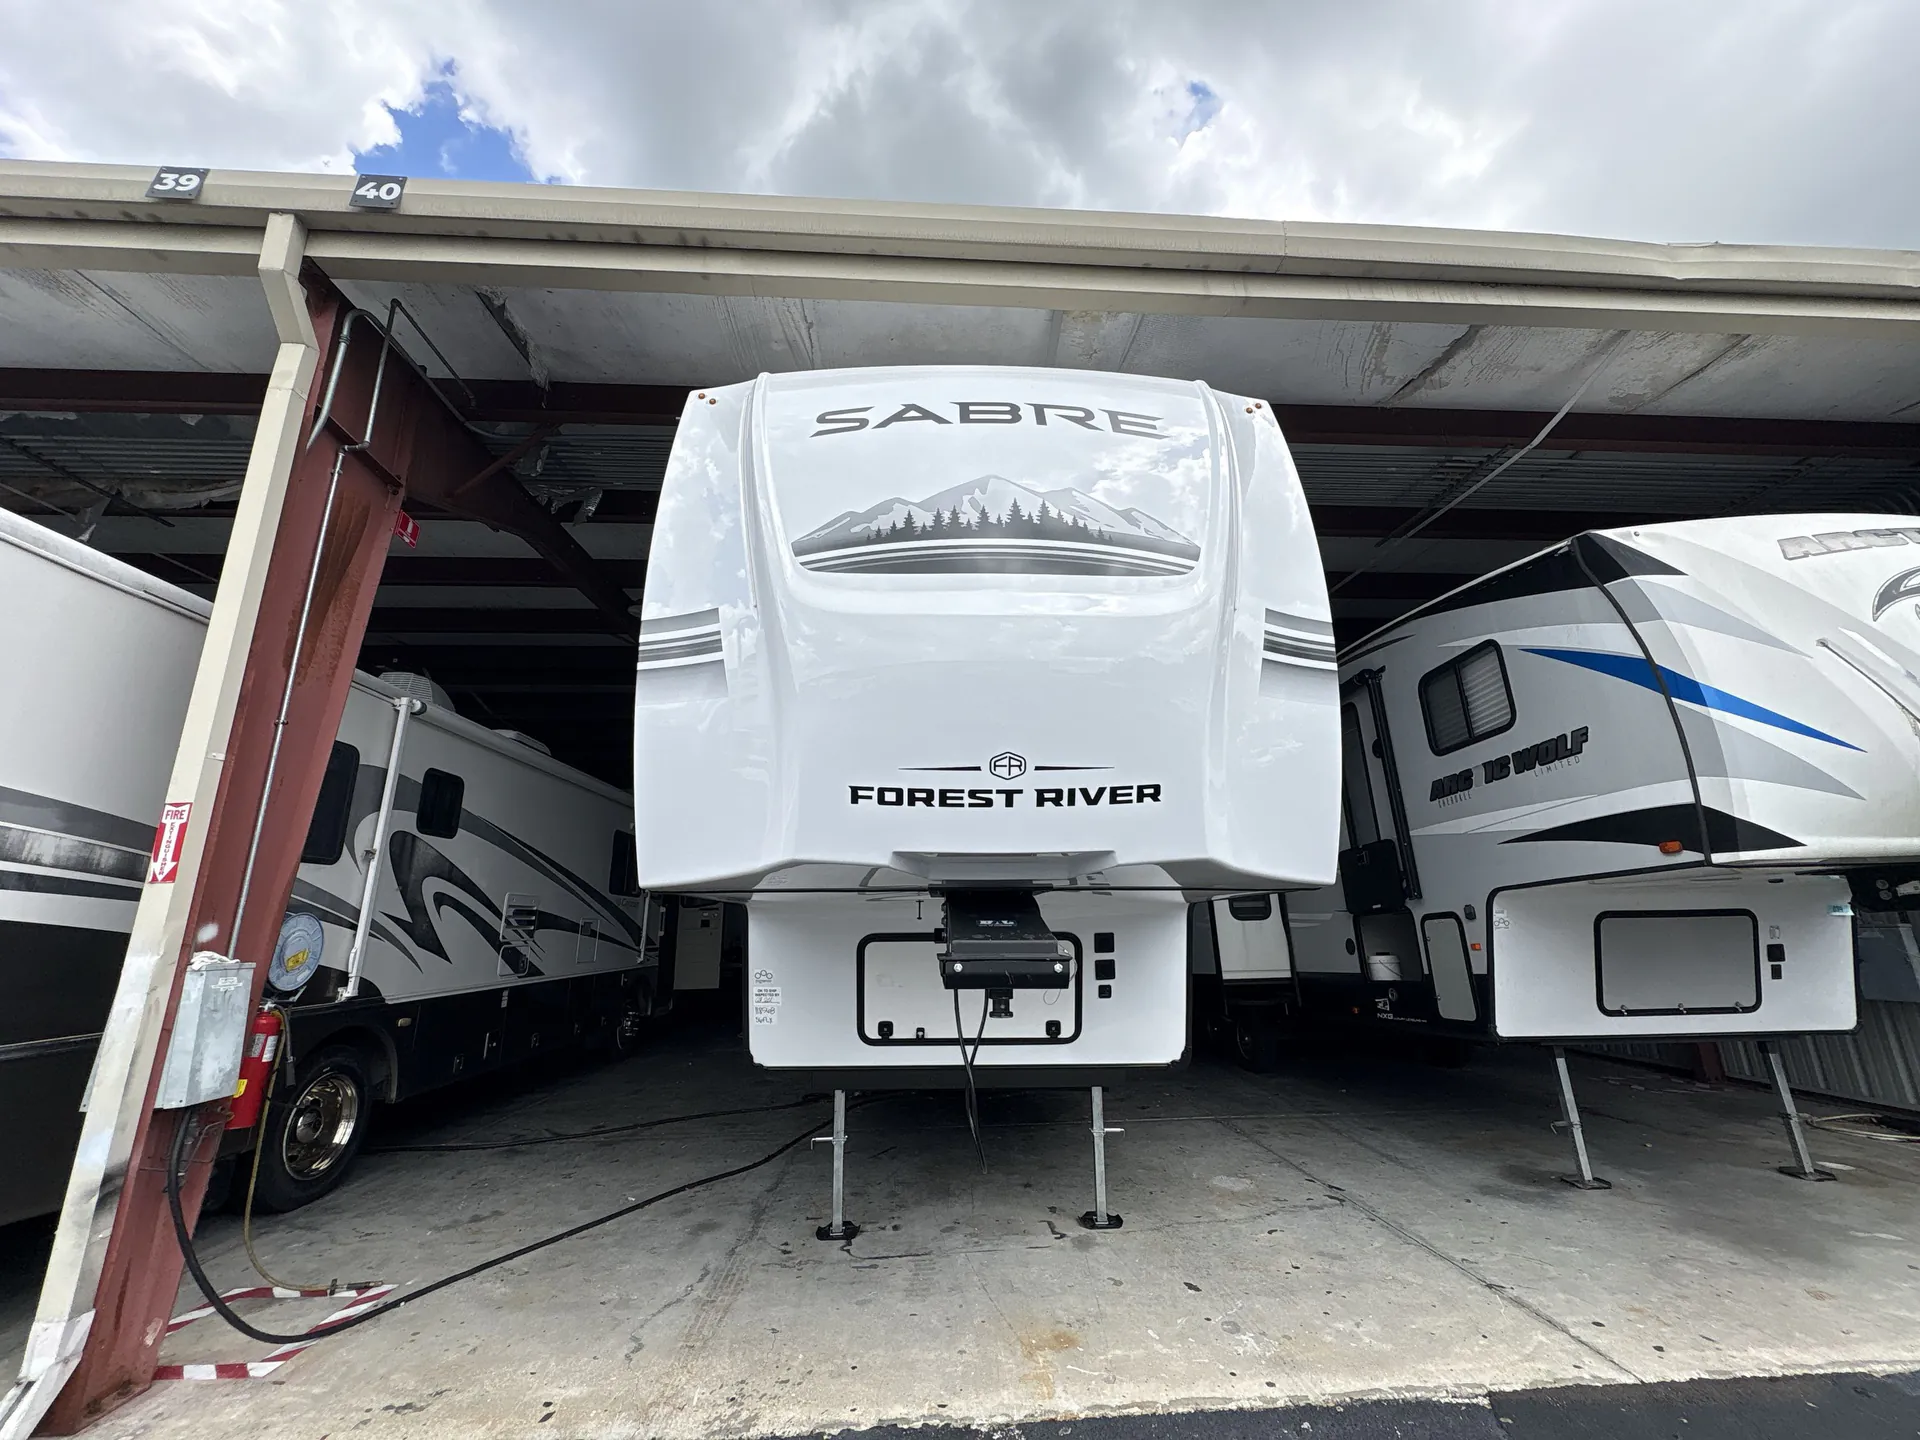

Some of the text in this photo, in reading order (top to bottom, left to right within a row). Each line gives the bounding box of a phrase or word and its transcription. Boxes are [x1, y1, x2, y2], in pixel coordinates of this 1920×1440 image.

[154, 173, 201, 192] 39
[355, 182, 401, 200] 40
[808, 401, 1172, 439] SABRE
[1511, 725, 1589, 775] WOLF
[992, 754, 1024, 778] FR
[1533, 754, 1581, 778] LIMITED
[848, 783, 1162, 808] FOREST RIVER
[164, 809, 187, 820] FIRE
[158, 821, 177, 876] EXTINGUISHER
